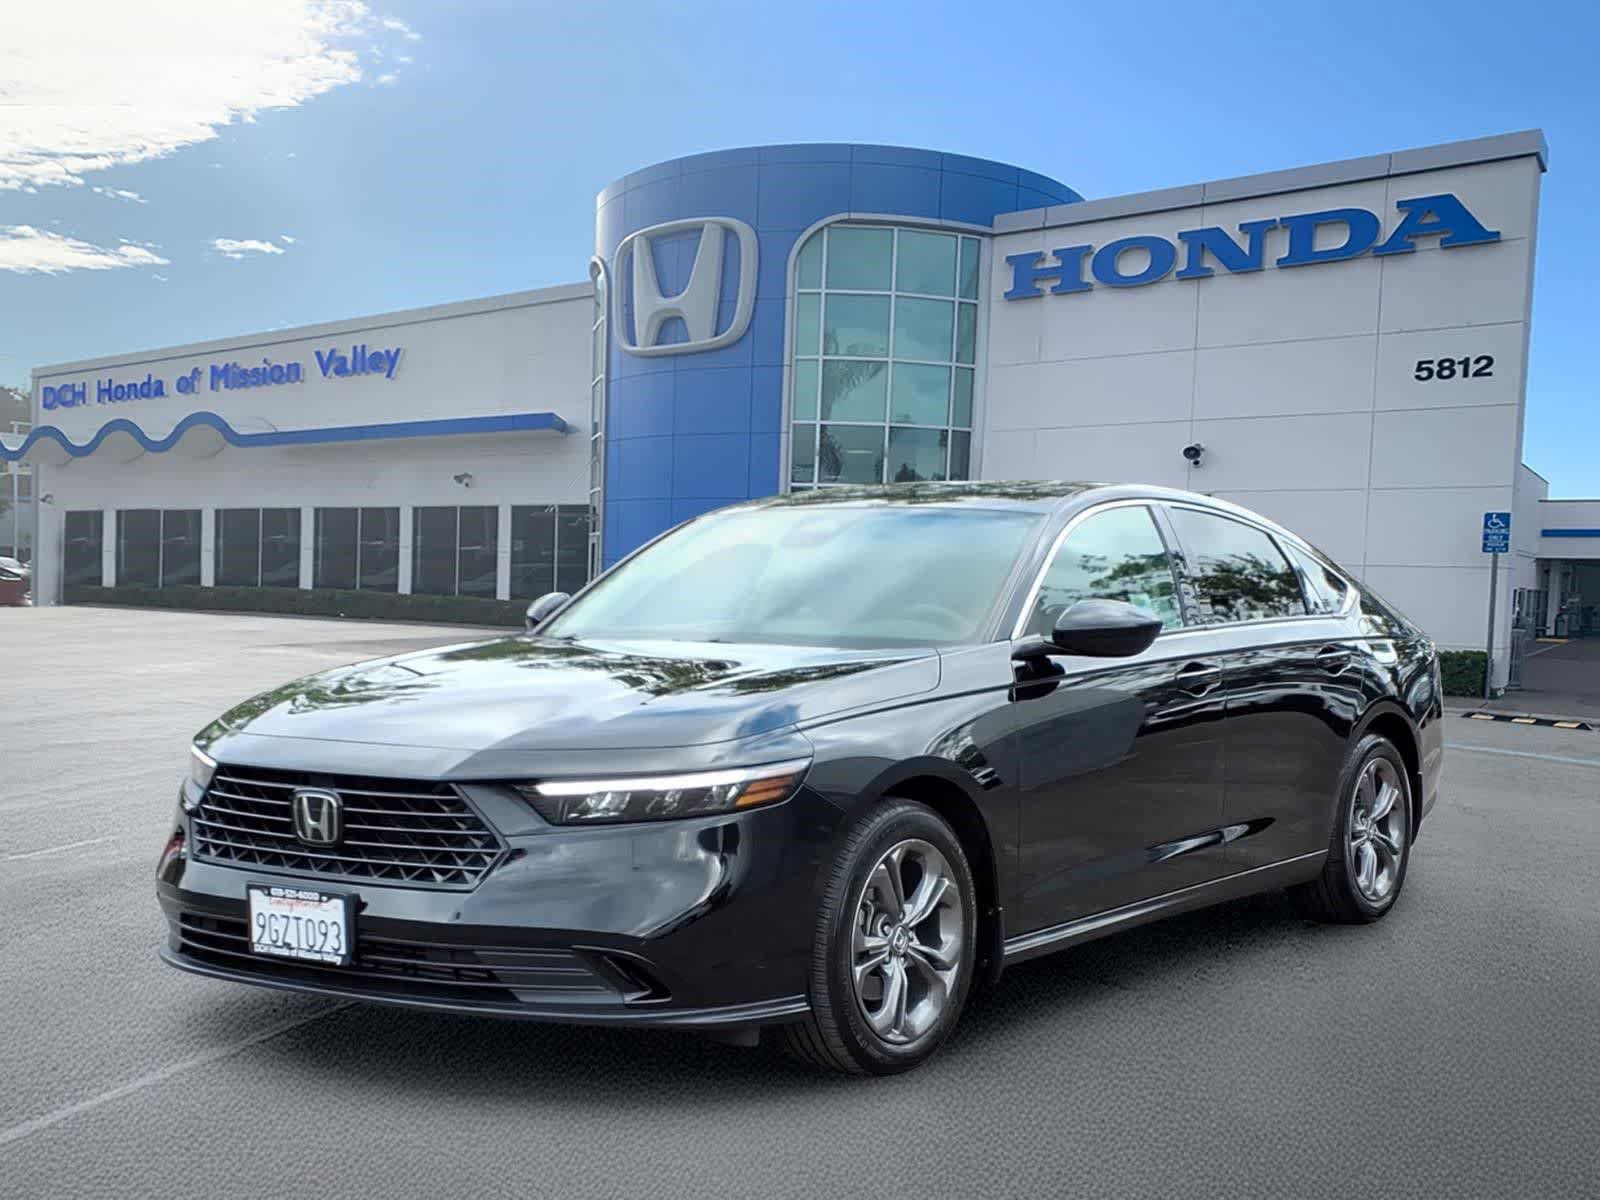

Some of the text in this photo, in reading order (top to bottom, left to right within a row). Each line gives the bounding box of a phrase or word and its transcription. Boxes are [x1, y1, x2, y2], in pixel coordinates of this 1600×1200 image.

[1003, 193, 1501, 300] HONDA
[42, 344, 402, 410] DCH Honda of Mission Valley
[1414, 355, 1494, 381] 5812
[256, 912, 342, 952] 9GZT093
